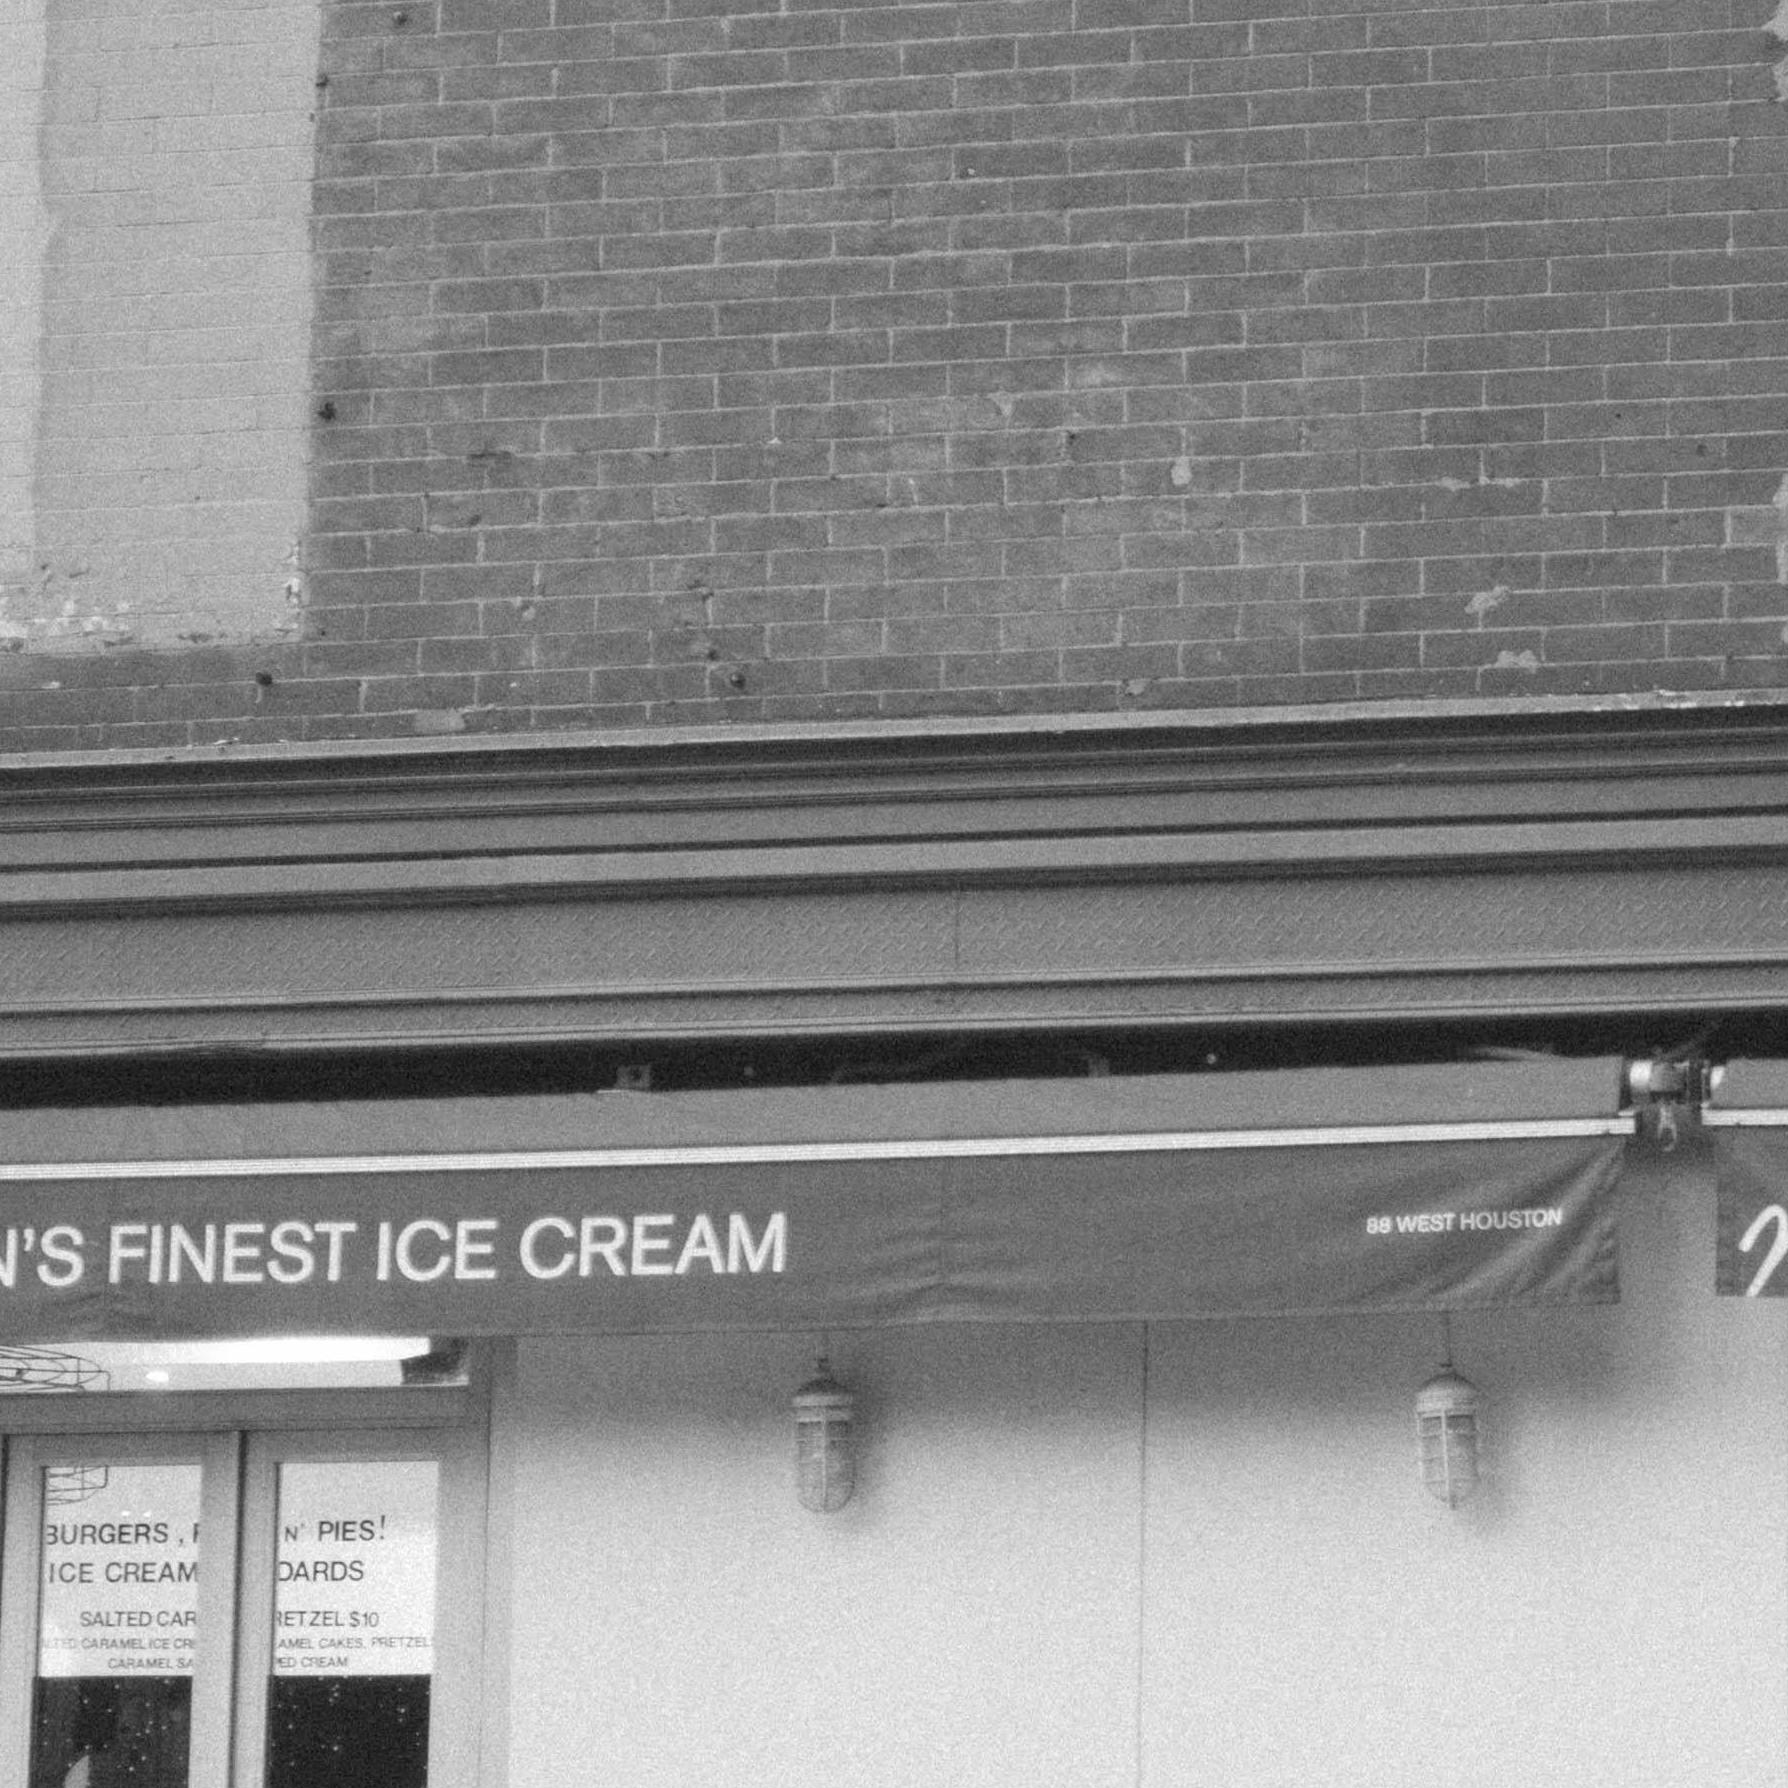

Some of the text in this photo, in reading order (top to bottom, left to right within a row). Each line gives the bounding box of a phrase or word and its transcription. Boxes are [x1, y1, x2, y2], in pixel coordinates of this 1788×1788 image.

[1366, 1207, 1564, 1234] 88 WEST HOUSTON
[108, 1222, 357, 1285] FINEST
[376, 1218, 497, 1281] ICE
[518, 1212, 786, 1279] CREAM
[318, 1515, 386, 1541] PIES!
[105, 1562, 199, 1583] CREAM
[80, 1611, 152, 1627] SALTED
